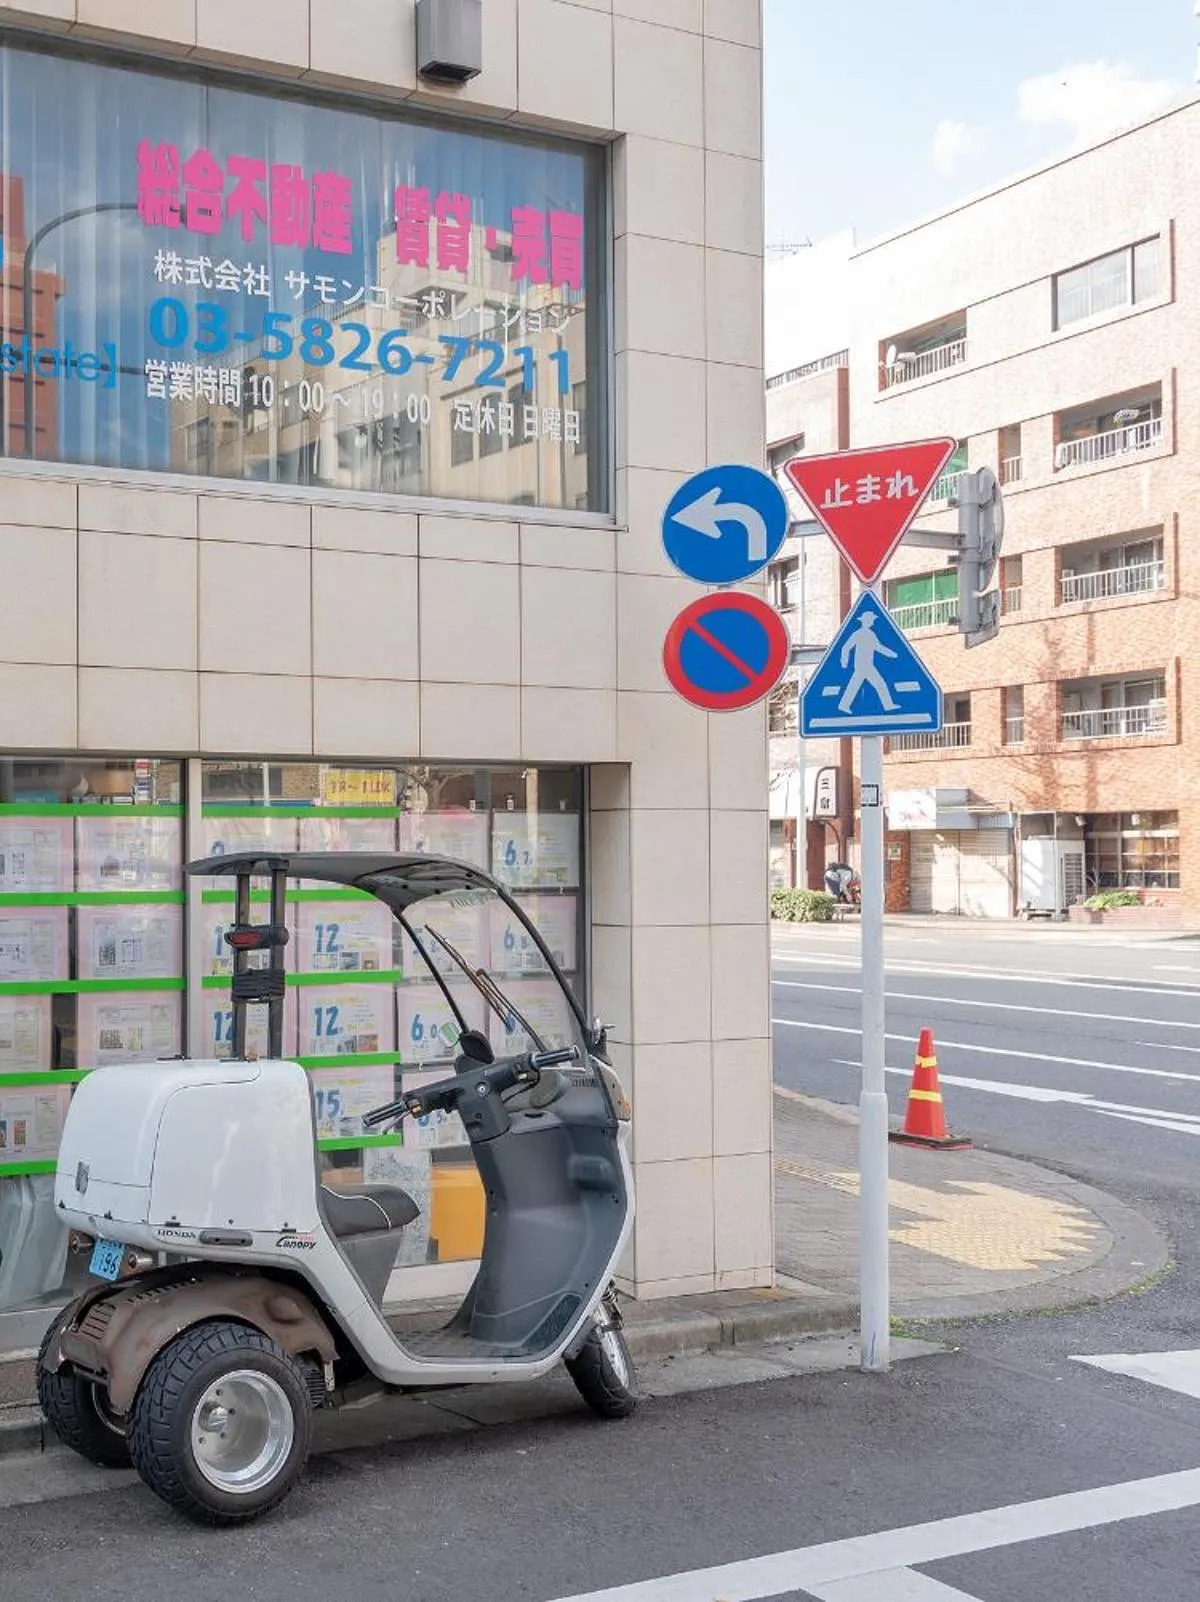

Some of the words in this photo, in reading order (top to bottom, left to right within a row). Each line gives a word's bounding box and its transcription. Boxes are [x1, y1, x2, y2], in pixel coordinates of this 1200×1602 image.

[136, 139, 353, 255] 総合不動産
[394, 184, 583, 290] 賃貸・売買
[154, 249, 270, 296] 株式会社
[284, 269, 570, 335] サモンコーポレーション
[149, 296, 570, 395] 03-5826-7211
[145, 359, 241, 408] 営業時間
[453, 399, 514, 436] 定休日
[523, 404, 580, 443] 日曜日
[820, 470, 919, 509] 止まれ
[157, 1229, 196, 1239] HONDA
